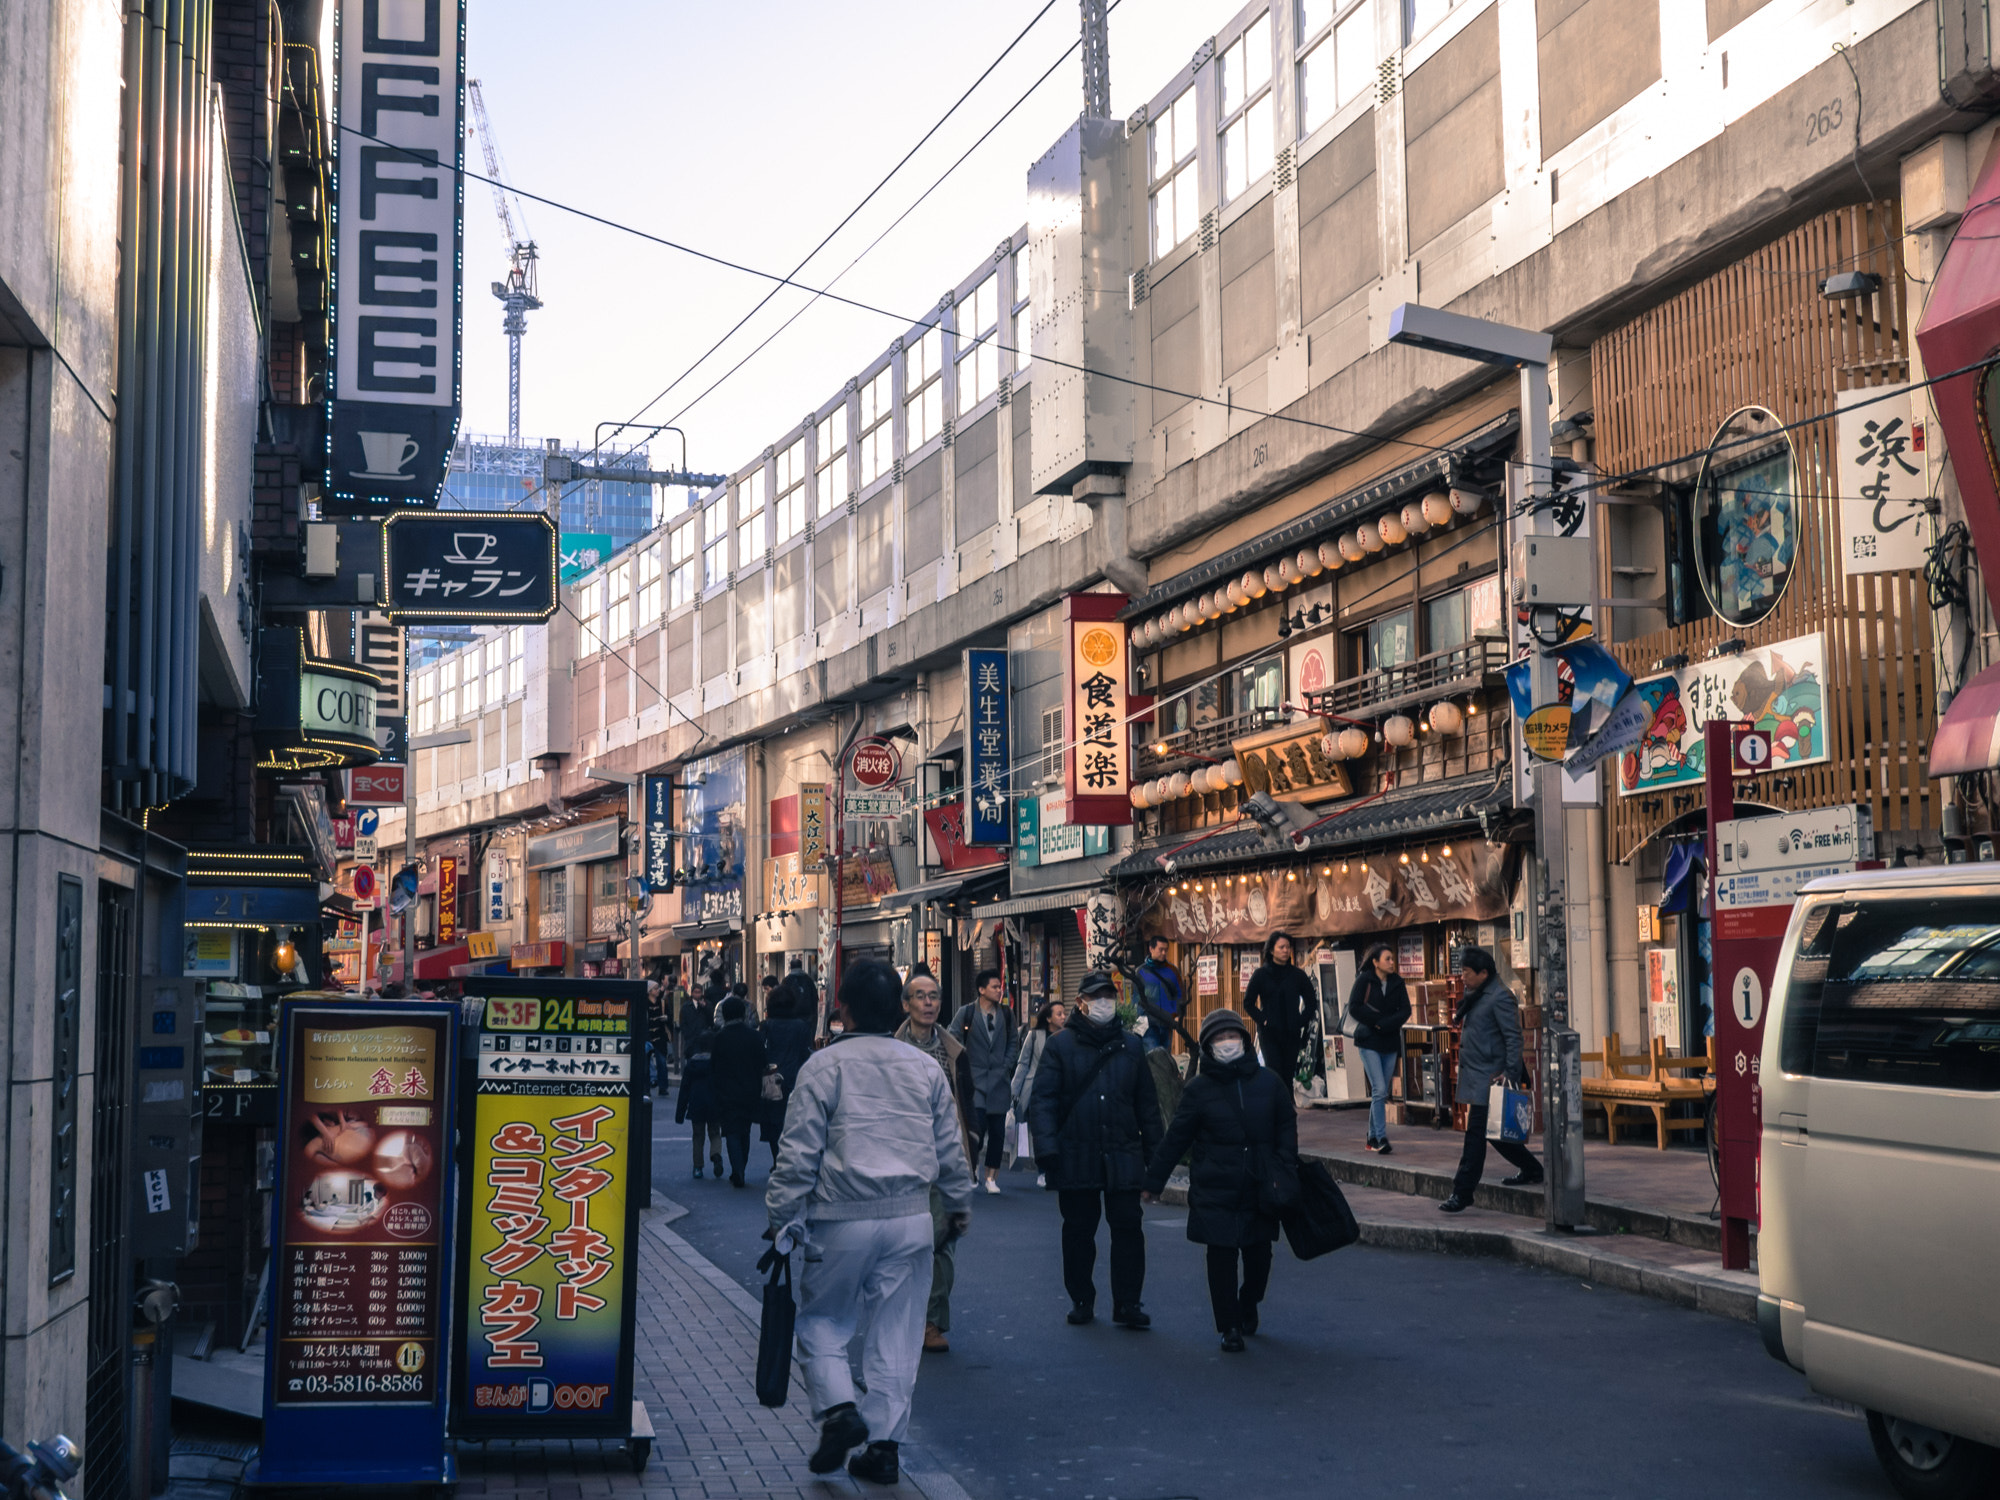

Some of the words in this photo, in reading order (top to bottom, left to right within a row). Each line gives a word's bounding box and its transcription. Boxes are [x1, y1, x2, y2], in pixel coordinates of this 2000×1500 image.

[1805, 96, 1843, 147] 263
[1253, 442, 1269, 469] 261
[1855, 417, 1920, 534] 浜よし
[403, 568, 537, 599] ギャラン
[1081, 671, 1119, 788] 食道楽
[976, 663, 1001, 825] 美生堂薬局
[857, 757, 891, 774] 消火栓
[355, 776, 399, 792] 宝くじ
[806, 810, 822, 856] 大江戸
[1020, 821, 1031, 833] your
[1814, 835, 1830, 848] FREE
[1832, 832, 1850, 846] Wi-Fi
[438, 859, 456, 941] ラーメン・餃子
[491, 1017, 508, 1025] 受付
[511, 1002, 537, 1026] 3F
[544, 1000, 575, 1031] 24
[577, 1020, 627, 1032] 時間営業
[490, 1057, 620, 1075] インターネットカフェ
[314, 1077, 353, 1089] しんらい
[368, 1066, 429, 1097] 鑫来
[512, 1082, 566, 1095] Internet
[569, 1083, 597, 1096] Cafe
[207, 1094, 253, 1117] 2F
[547, 1106, 614, 1318] インターネット
[371, 1250, 389, 1260] 30分
[398, 1251, 427, 1260] 3,000円
[370, 1264, 388, 1273] 30分
[398, 1264, 427, 1273] 3,000円
[370, 1277, 388, 1286] 45分
[398, 1277, 426, 1286] 4,500円
[369, 1290, 387, 1299] 60分
[397, 1290, 425, 1300] 5,000円
[293, 1302, 354, 1313] 全身基本コース
[368, 1303, 387, 1312] 60分
[396, 1303, 425, 1313] 6,000円
[292, 1315, 358, 1326] 全身オイルコース
[368, 1316, 386, 1326] 60分
[396, 1316, 425, 1326] 8,000円
[359, 1359, 392, 1368] 年中無休
[398, 1347, 425, 1367] 4F
[306, 1374, 423, 1393] 03-5816-8586
